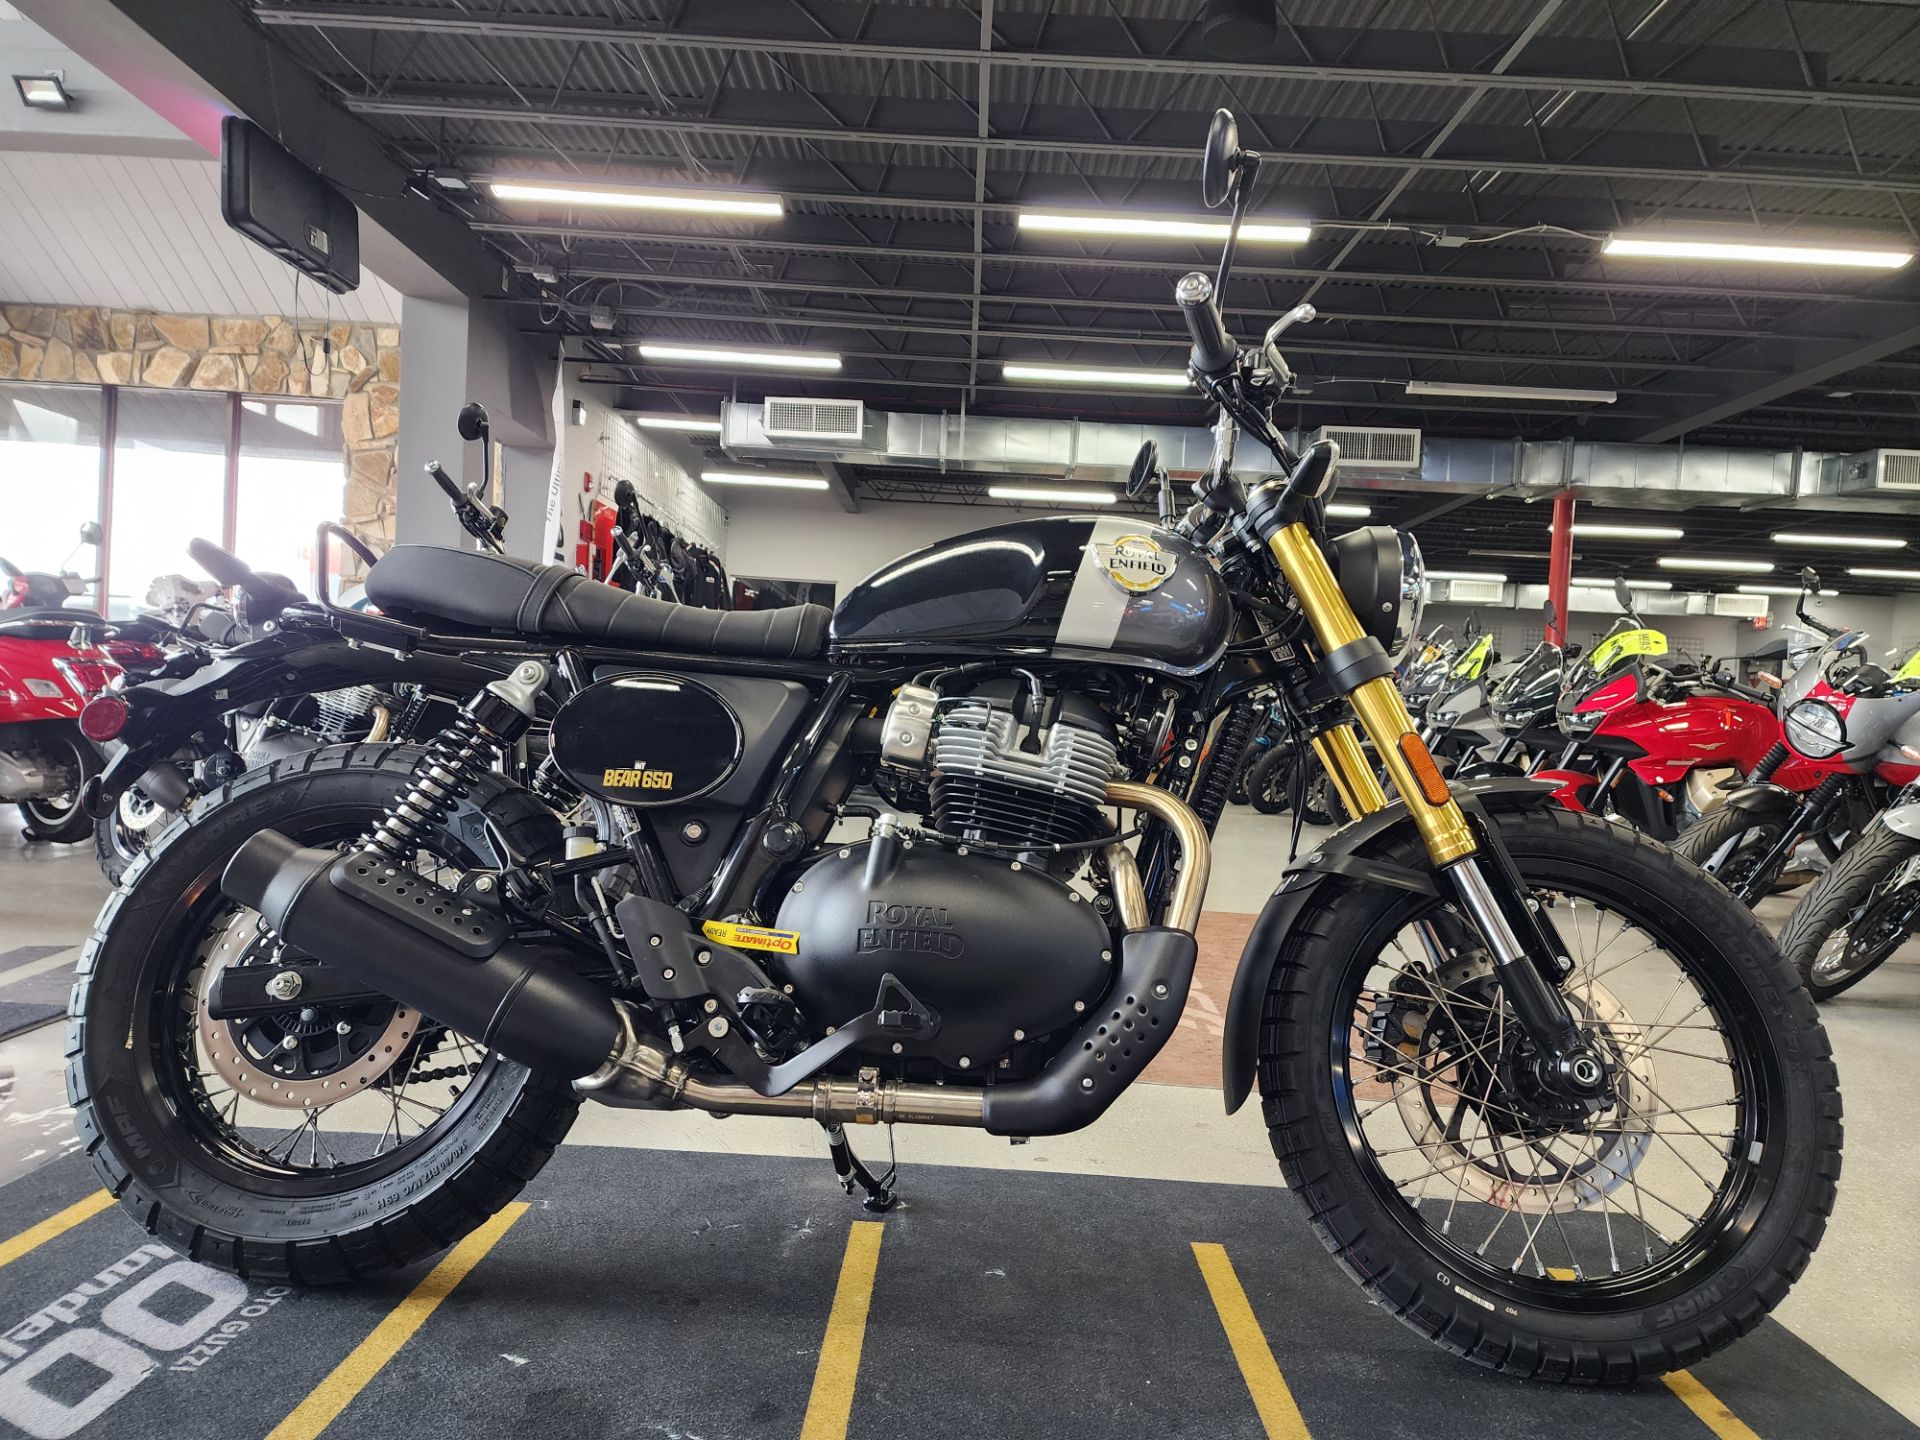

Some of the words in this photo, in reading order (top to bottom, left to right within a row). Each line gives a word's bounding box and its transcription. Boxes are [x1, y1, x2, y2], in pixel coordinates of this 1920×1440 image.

[1110, 558, 1167, 575] ENFIELD
[603, 769, 641, 787] BEAR
[642, 771, 673, 789] 650
[866, 900, 953, 929] ROYAL
[706, 927, 728, 938] READY
[857, 927, 965, 960] ENFIELD
[106, 1095, 153, 1160] MRF
[1655, 1282, 1723, 1329] MRF
[168, 1319, 250, 1372] GUZZI
